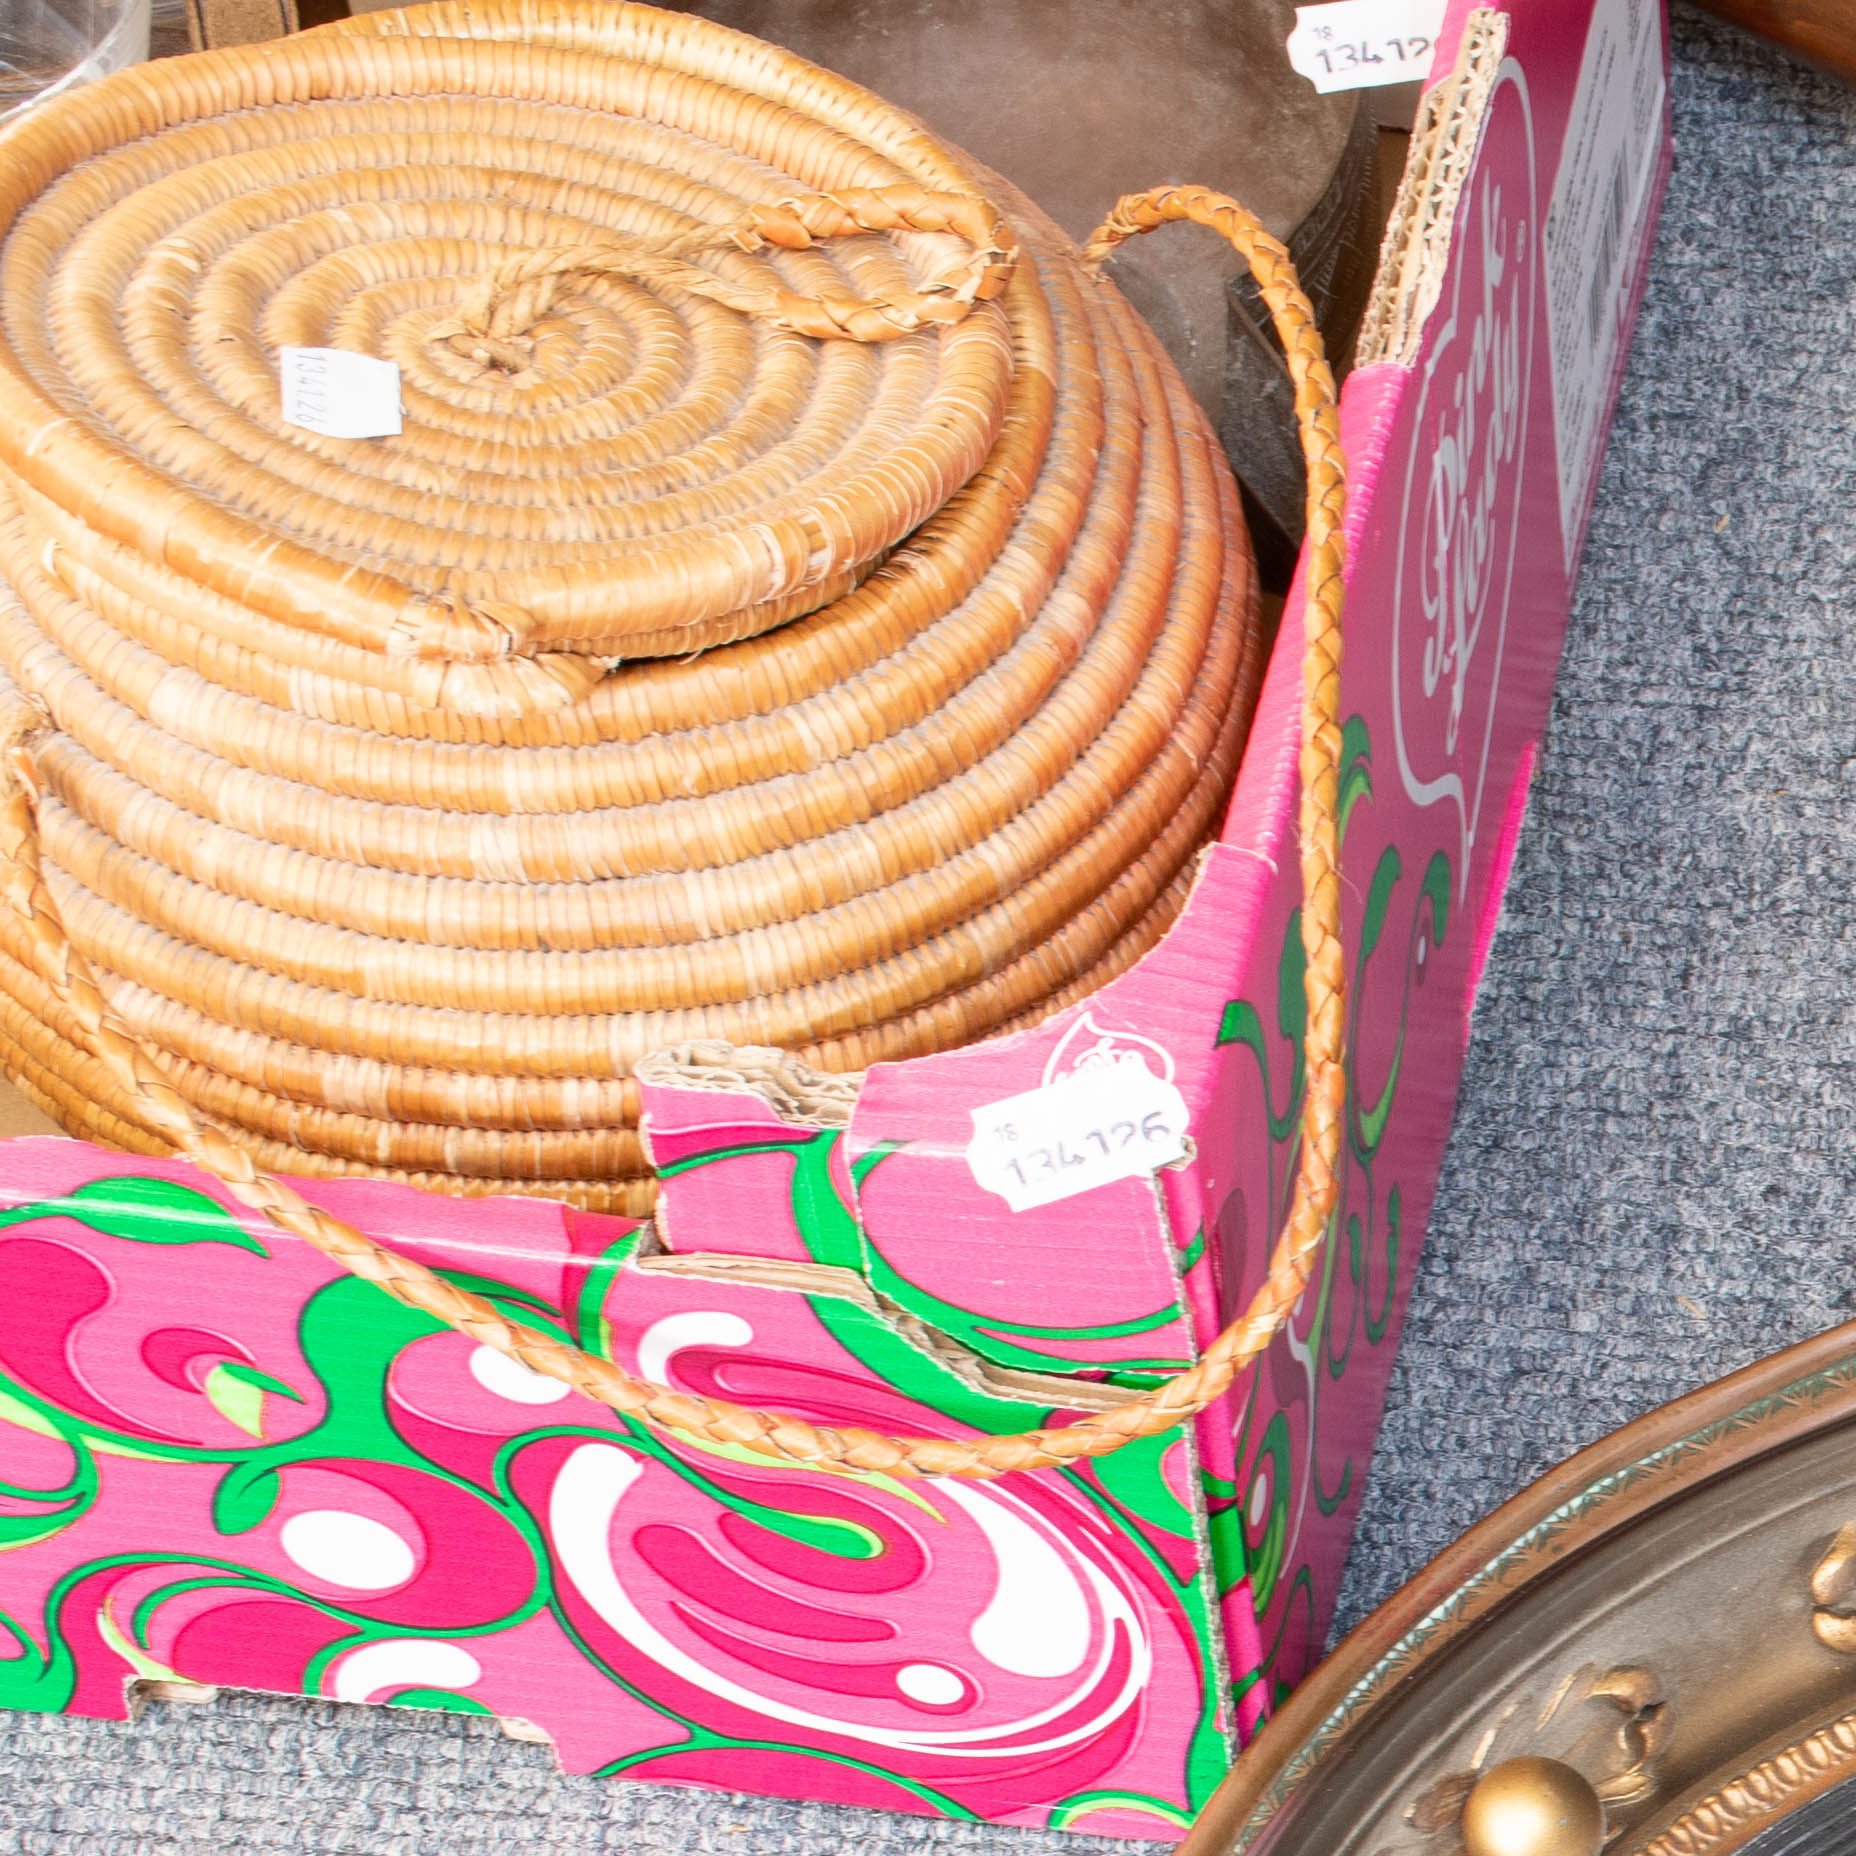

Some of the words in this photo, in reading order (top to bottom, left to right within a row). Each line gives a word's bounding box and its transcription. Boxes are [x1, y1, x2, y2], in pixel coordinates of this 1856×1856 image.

[1314, 36, 1437, 74] 13412
[1421, 166, 1506, 698] Pink
[1444, 272, 1521, 757] Lady
